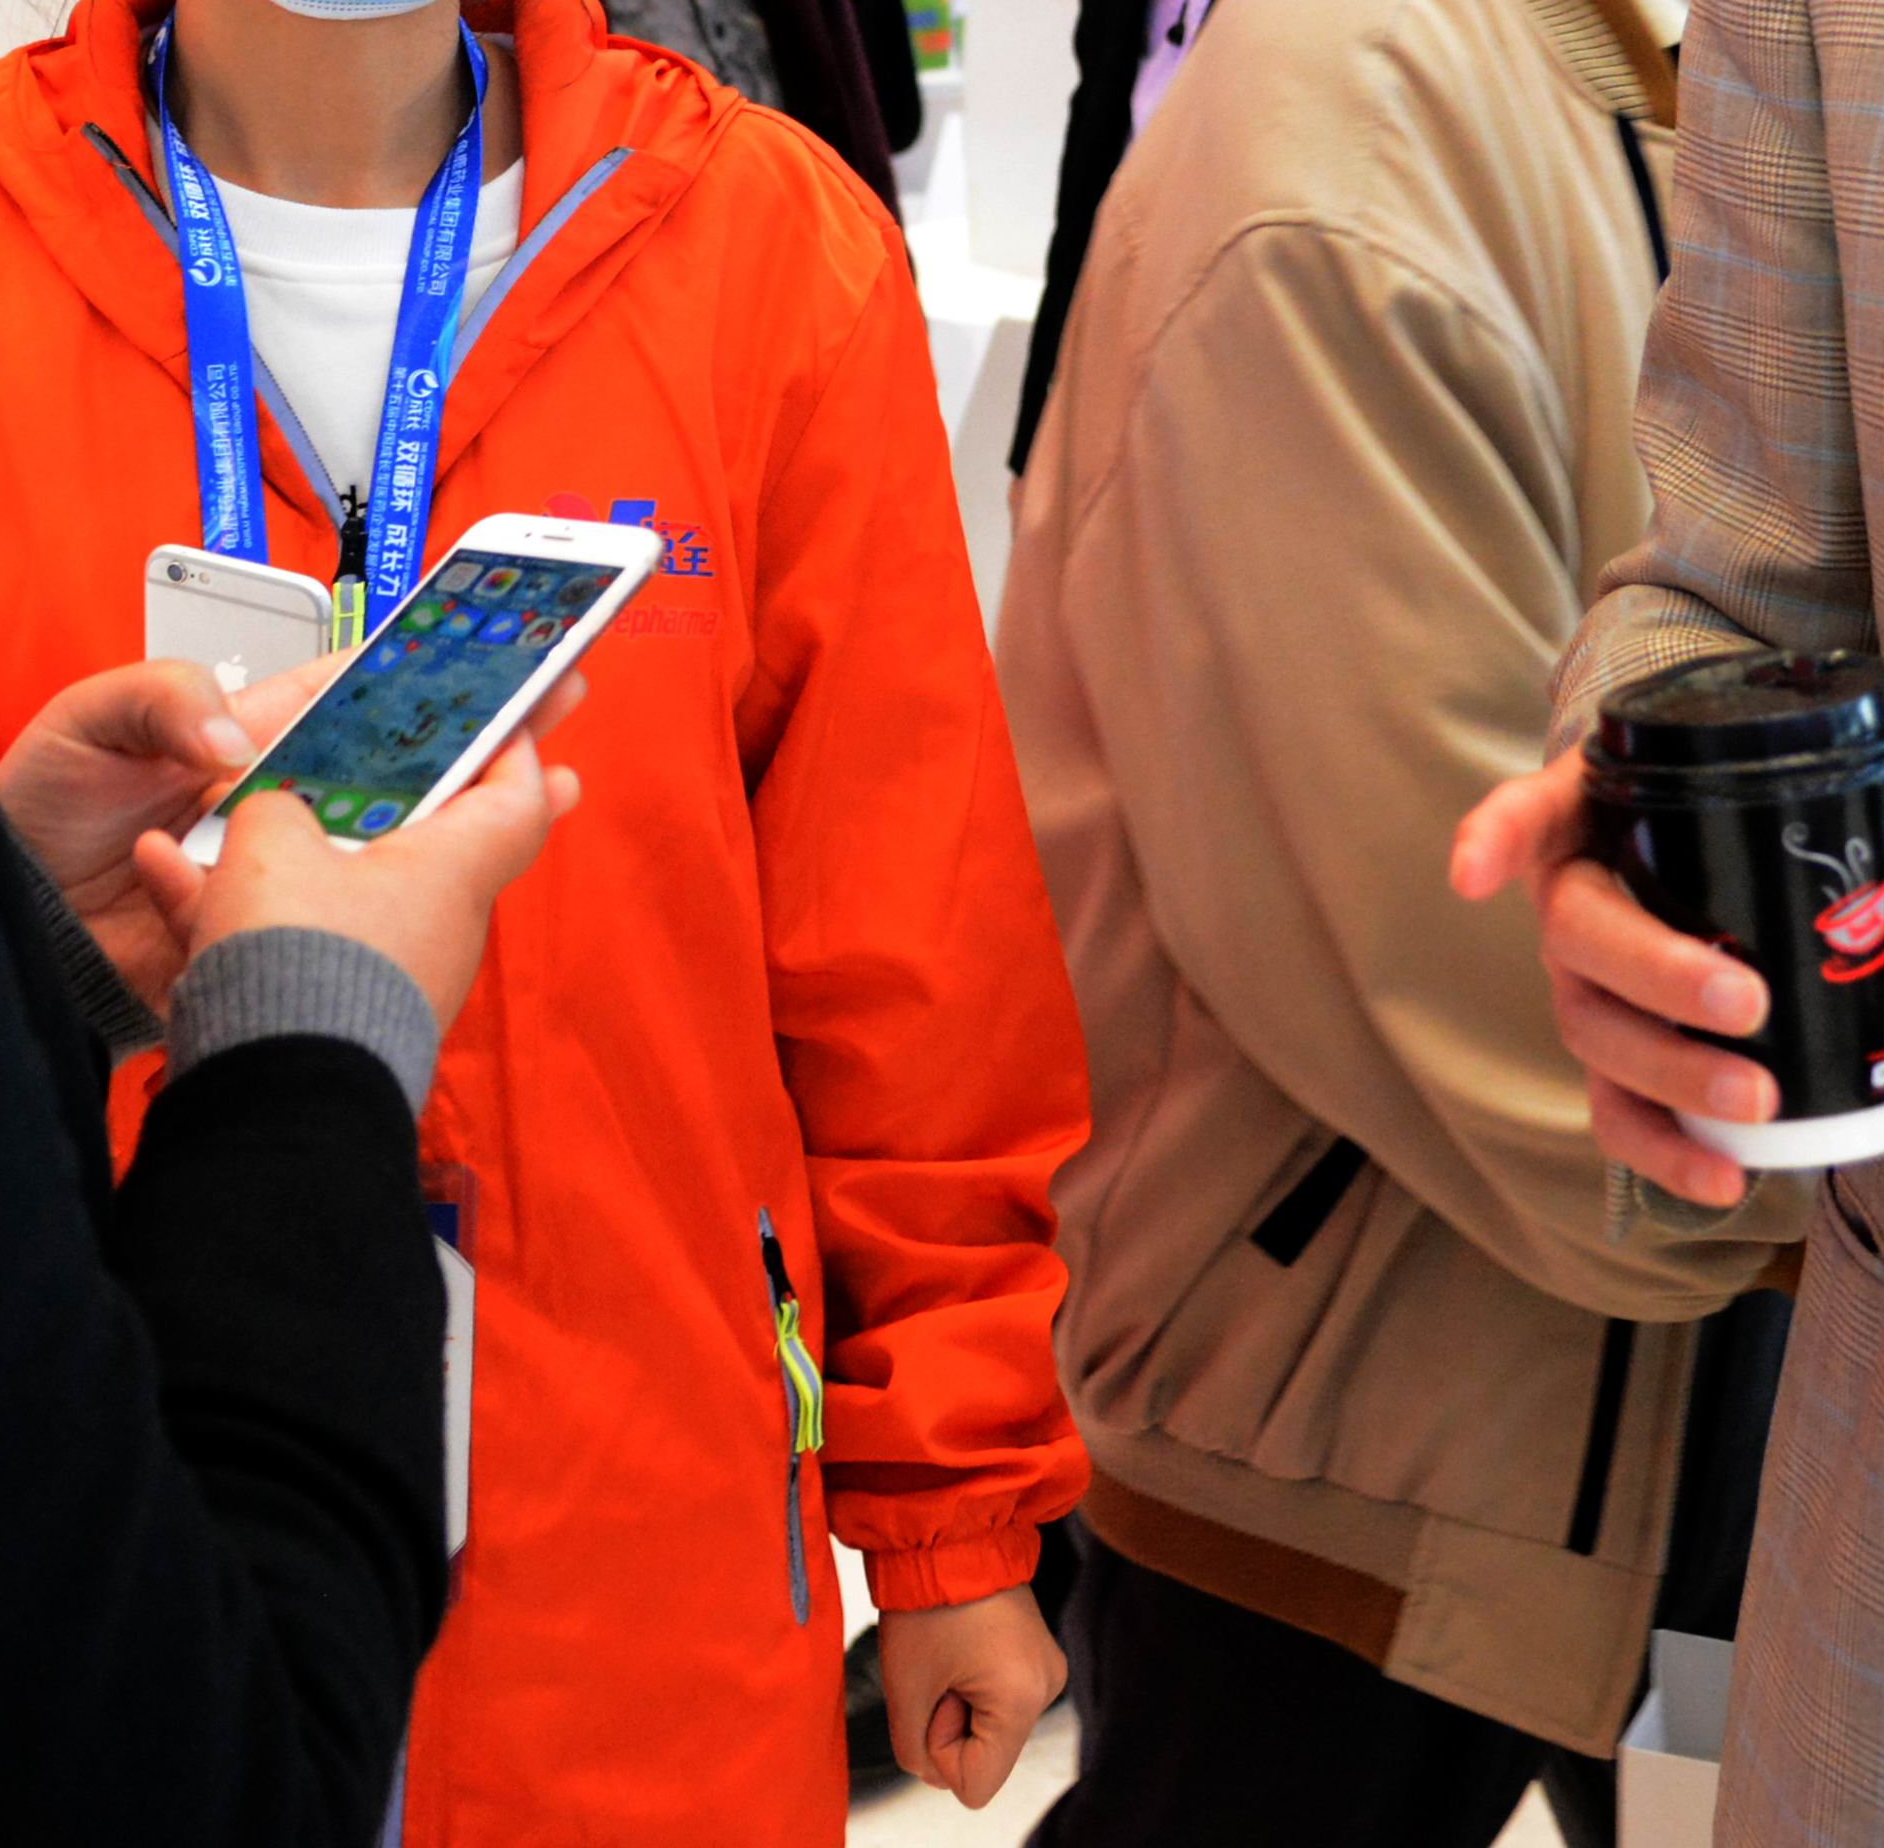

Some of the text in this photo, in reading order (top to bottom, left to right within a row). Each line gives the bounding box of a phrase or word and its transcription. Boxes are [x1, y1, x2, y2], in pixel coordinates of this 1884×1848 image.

[375, 438, 420, 598] 双循环 成长力
